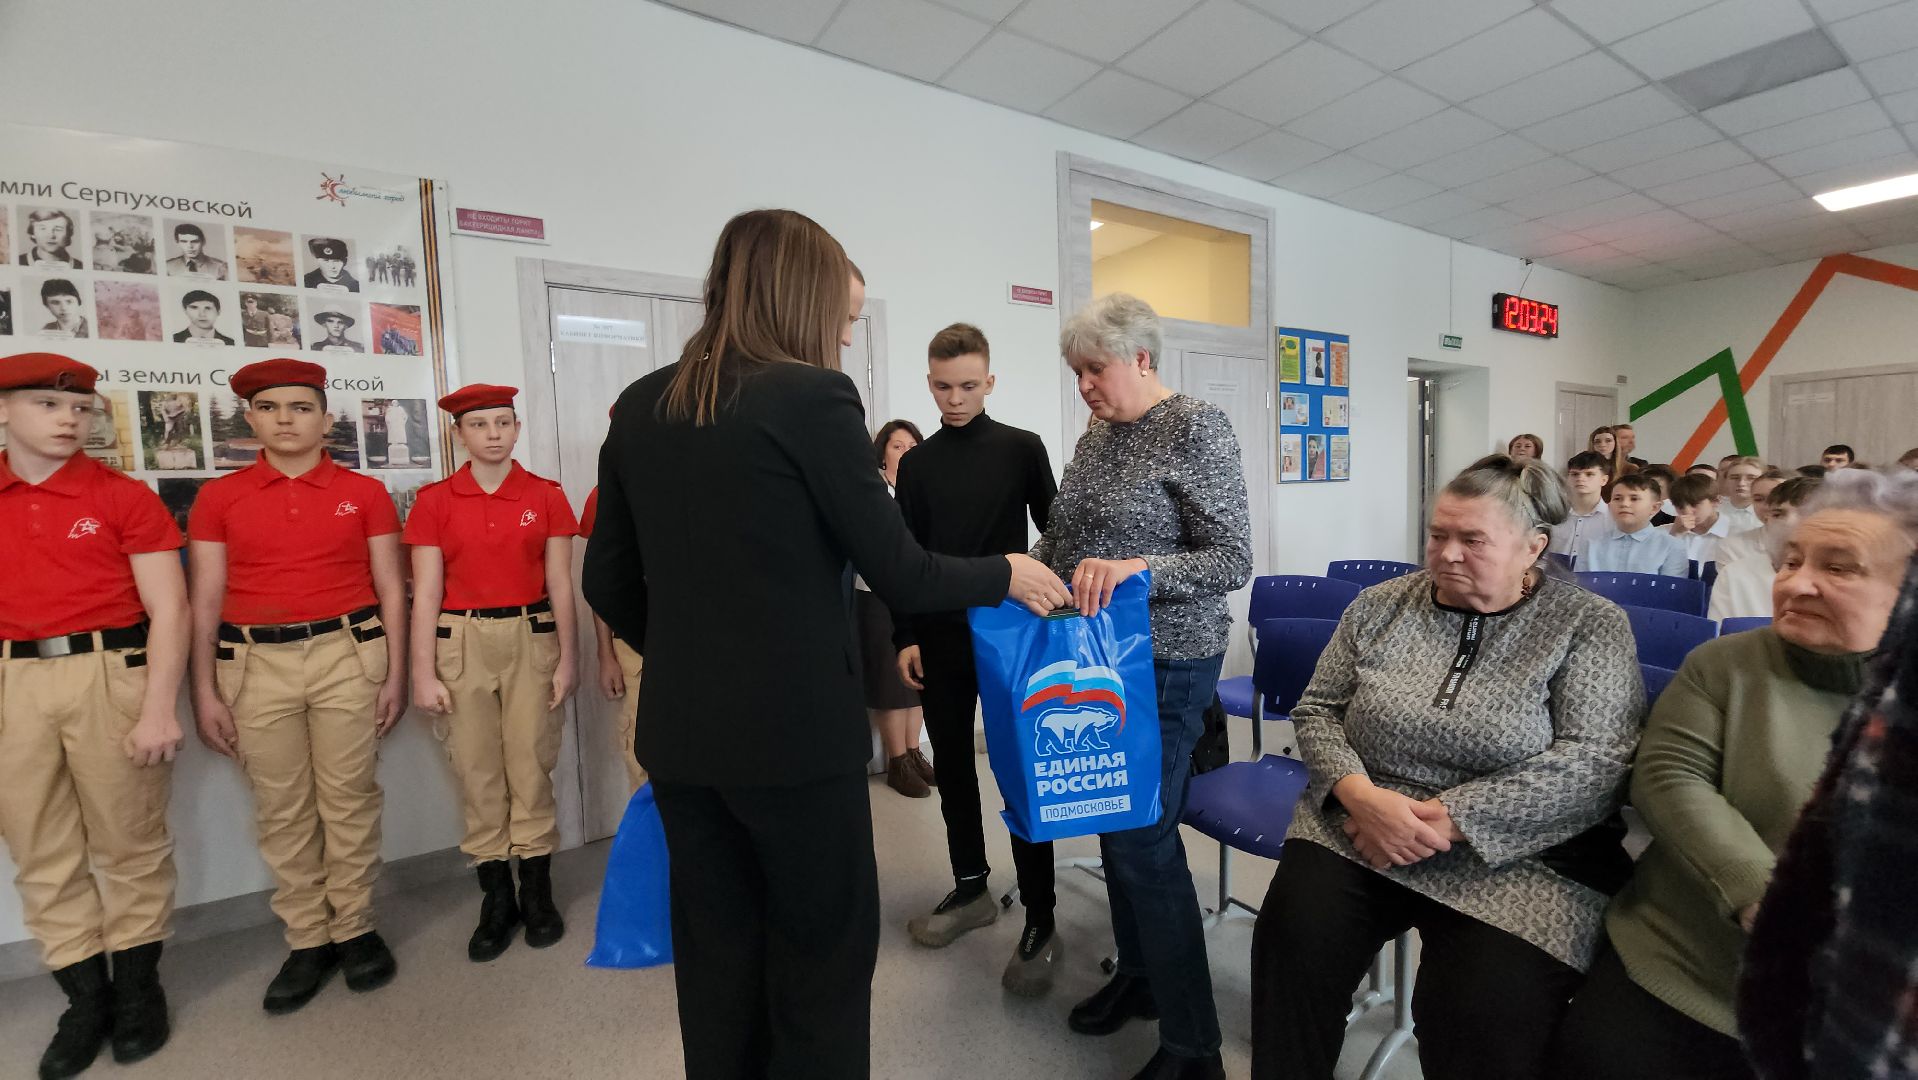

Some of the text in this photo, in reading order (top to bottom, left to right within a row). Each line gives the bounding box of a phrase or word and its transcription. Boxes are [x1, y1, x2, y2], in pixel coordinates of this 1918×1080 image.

[60, 181, 253, 219] Серпуховской
[118, 369, 201, 385] земли
[1034, 751, 1126, 777] ЕДИНАЯ
[1036, 769, 1128, 797] РОССИЯ
[1045, 798, 1125, 819] ПОДМОСКОВЬЕ
